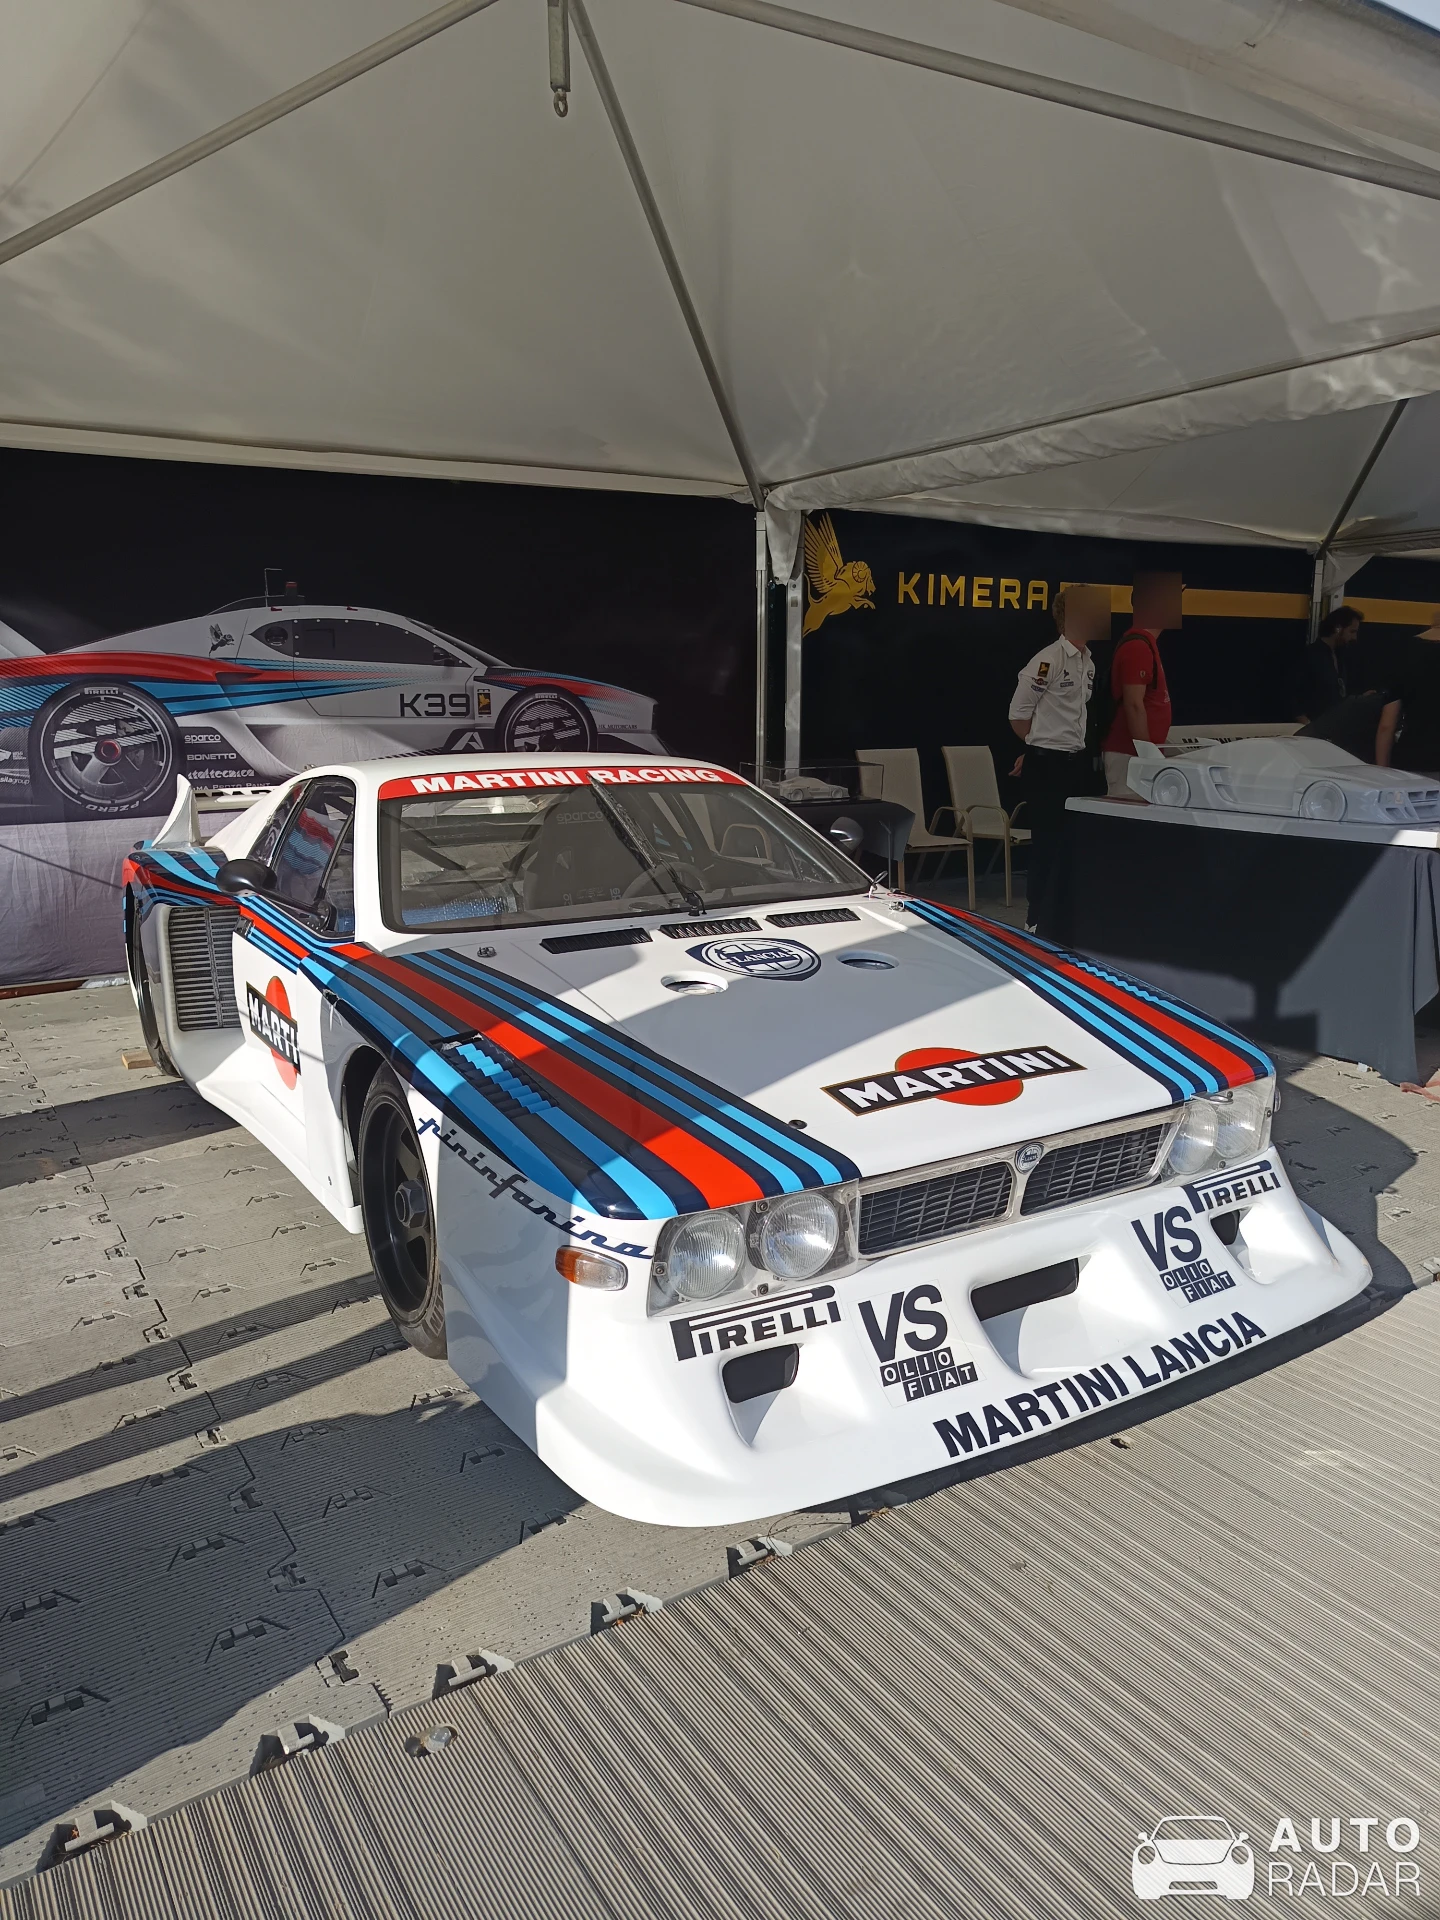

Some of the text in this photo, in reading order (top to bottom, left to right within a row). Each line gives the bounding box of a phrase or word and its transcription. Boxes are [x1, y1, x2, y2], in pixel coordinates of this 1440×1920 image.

[898, 572, 1049, 610] KIMERA
[84, 687, 119, 695] PIRELLI
[400, 693, 471, 717] K39
[184, 734, 221, 744] sparco
[186, 752, 237, 761] BONETTO
[410, 768, 724, 793] MARTINI RACING
[556, 811, 604, 824] sparco
[731, 949, 791, 964] LANCIA
[838, 1050, 1071, 1109] MARTINI
[417, 1117, 653, 1260] pininfarina
[1181, 1159, 1282, 1214] PIRELLI
[1131, 1205, 1202, 1272] VS
[1162, 1260, 1212, 1289] OLIO
[1183, 1272, 1234, 1301] FIAT
[669, 1285, 842, 1362] PIRELLI
[858, 1284, 948, 1363] VS
[882, 1350, 952, 1384] OLIO
[906, 1364, 975, 1399] FIAT
[932, 1311, 1266, 1458] MARTINI LANCIA
